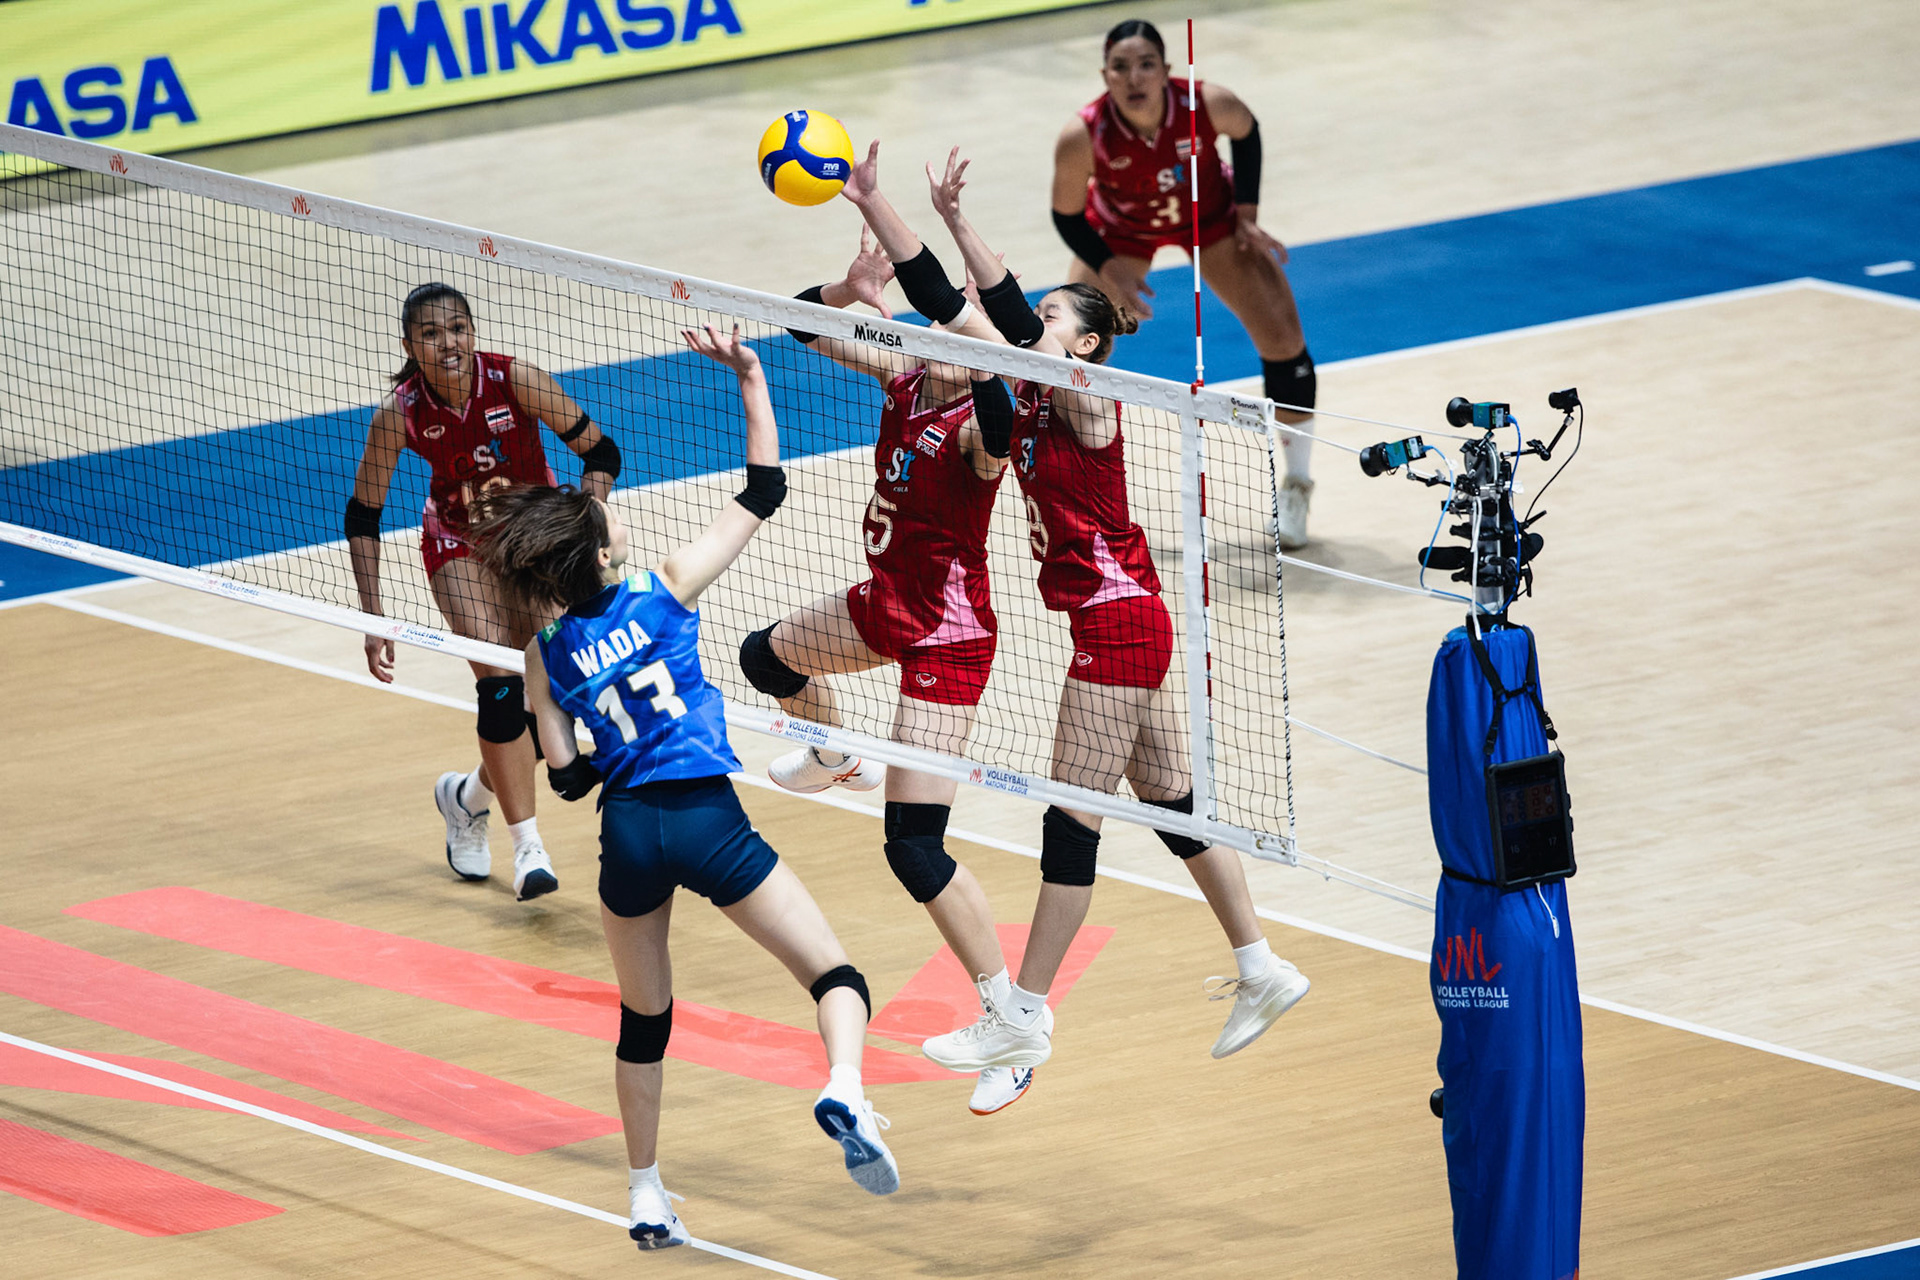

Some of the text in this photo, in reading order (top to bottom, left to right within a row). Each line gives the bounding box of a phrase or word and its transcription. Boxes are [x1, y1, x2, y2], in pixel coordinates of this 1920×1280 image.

[109, 154, 128, 175] VNL
[291, 194, 312, 216] VNL
[1148, 196, 1181, 228] 3
[478, 235, 498, 258] VNL
[670, 279, 691, 300] VNL
[1070, 366, 1091, 388] VNL
[865, 490, 897, 556] 5
[571, 619, 652, 678] WADA
[788, 720, 829, 738] VOLLEYBALL
[985, 780, 1007, 791] NATIONS
[986, 768, 1029, 787] VOLLEYBALL
[1436, 926, 1502, 982] VNL
[1437, 985, 1509, 998] VOLLEYBALL
[1473, 999, 1509, 1009] LEAGUE
